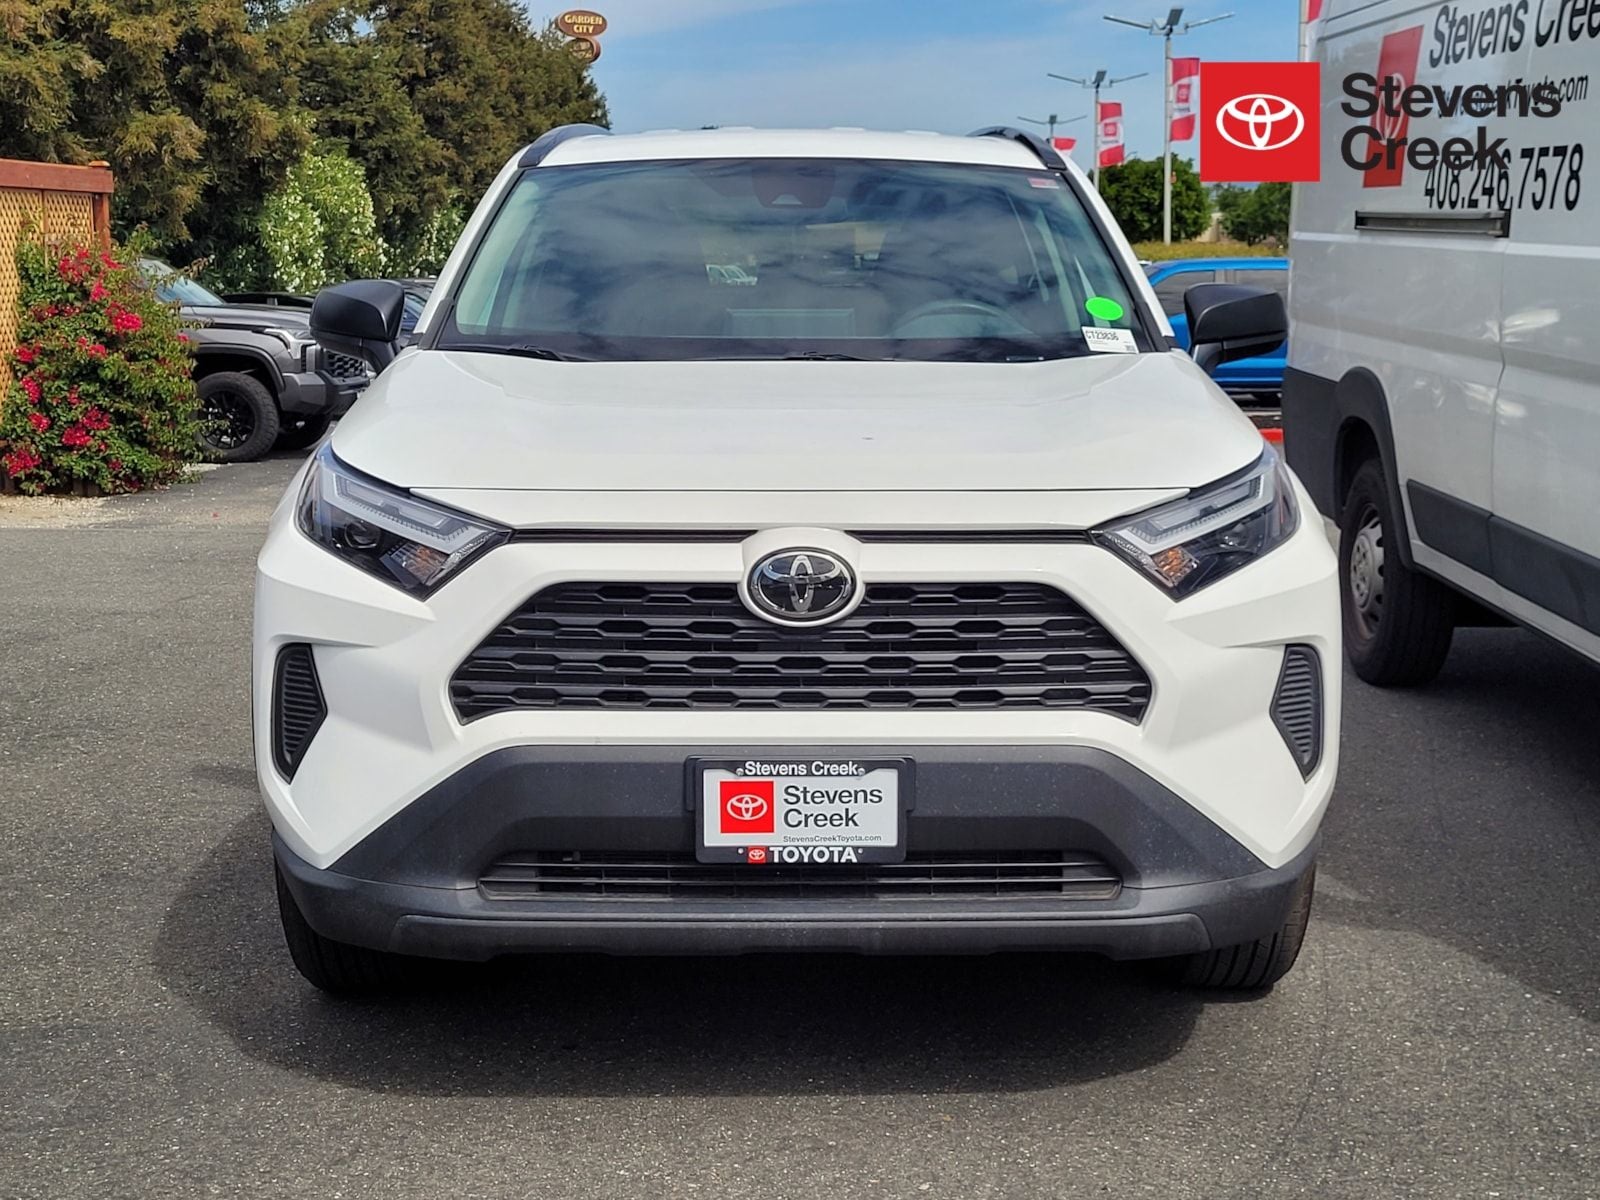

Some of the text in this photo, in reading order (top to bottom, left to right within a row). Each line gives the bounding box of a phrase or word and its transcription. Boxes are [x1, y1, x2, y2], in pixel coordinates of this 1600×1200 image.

[564, 14, 603, 25] GARDEN
[573, 24, 594, 33] CITY
[1429, 0, 1529, 68] Stevens
[744, 761, 858, 776] Stevens Creek
[783, 785, 883, 805] Stevens
[783, 808, 859, 828] Creek
[783, 834, 882, 844] StevensCreekToyota.com
[769, 846, 858, 863] TOYOTA
